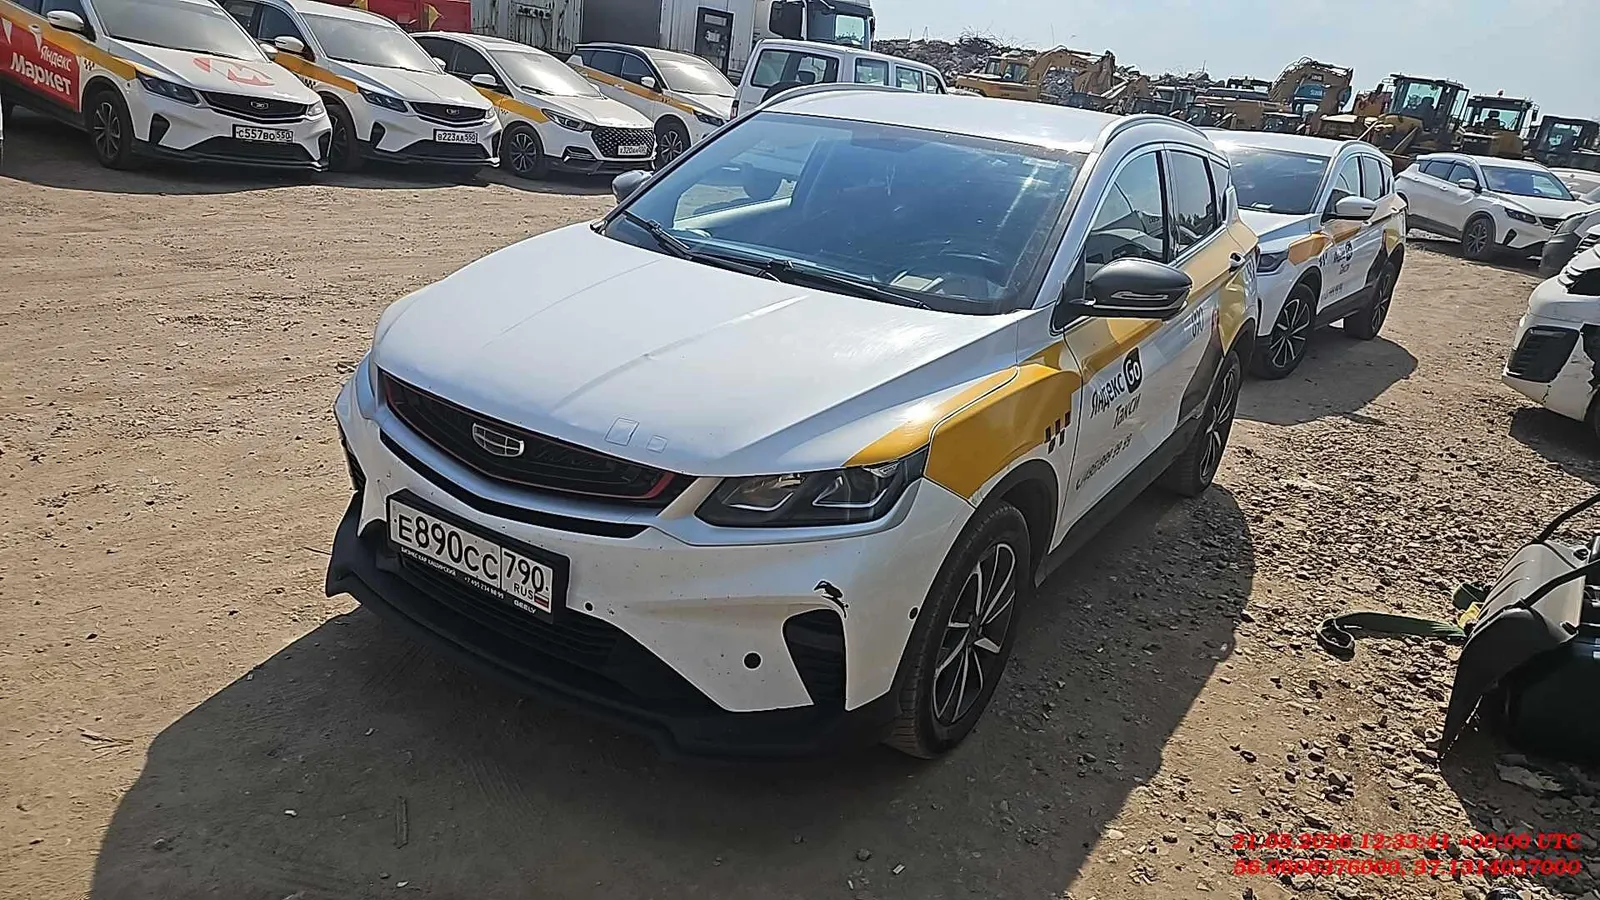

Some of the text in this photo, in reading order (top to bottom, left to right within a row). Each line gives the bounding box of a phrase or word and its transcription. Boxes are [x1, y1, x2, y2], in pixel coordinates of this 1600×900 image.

[10, 52, 72, 95] Маркет
[41, 45, 72, 71] Яндекс
[1090, 360, 1140, 419] Яндекс Go
[1113, 393, 1141, 430] Такси
[514, 582, 534, 600] RUS
[513, 600, 537, 614] GEELY
